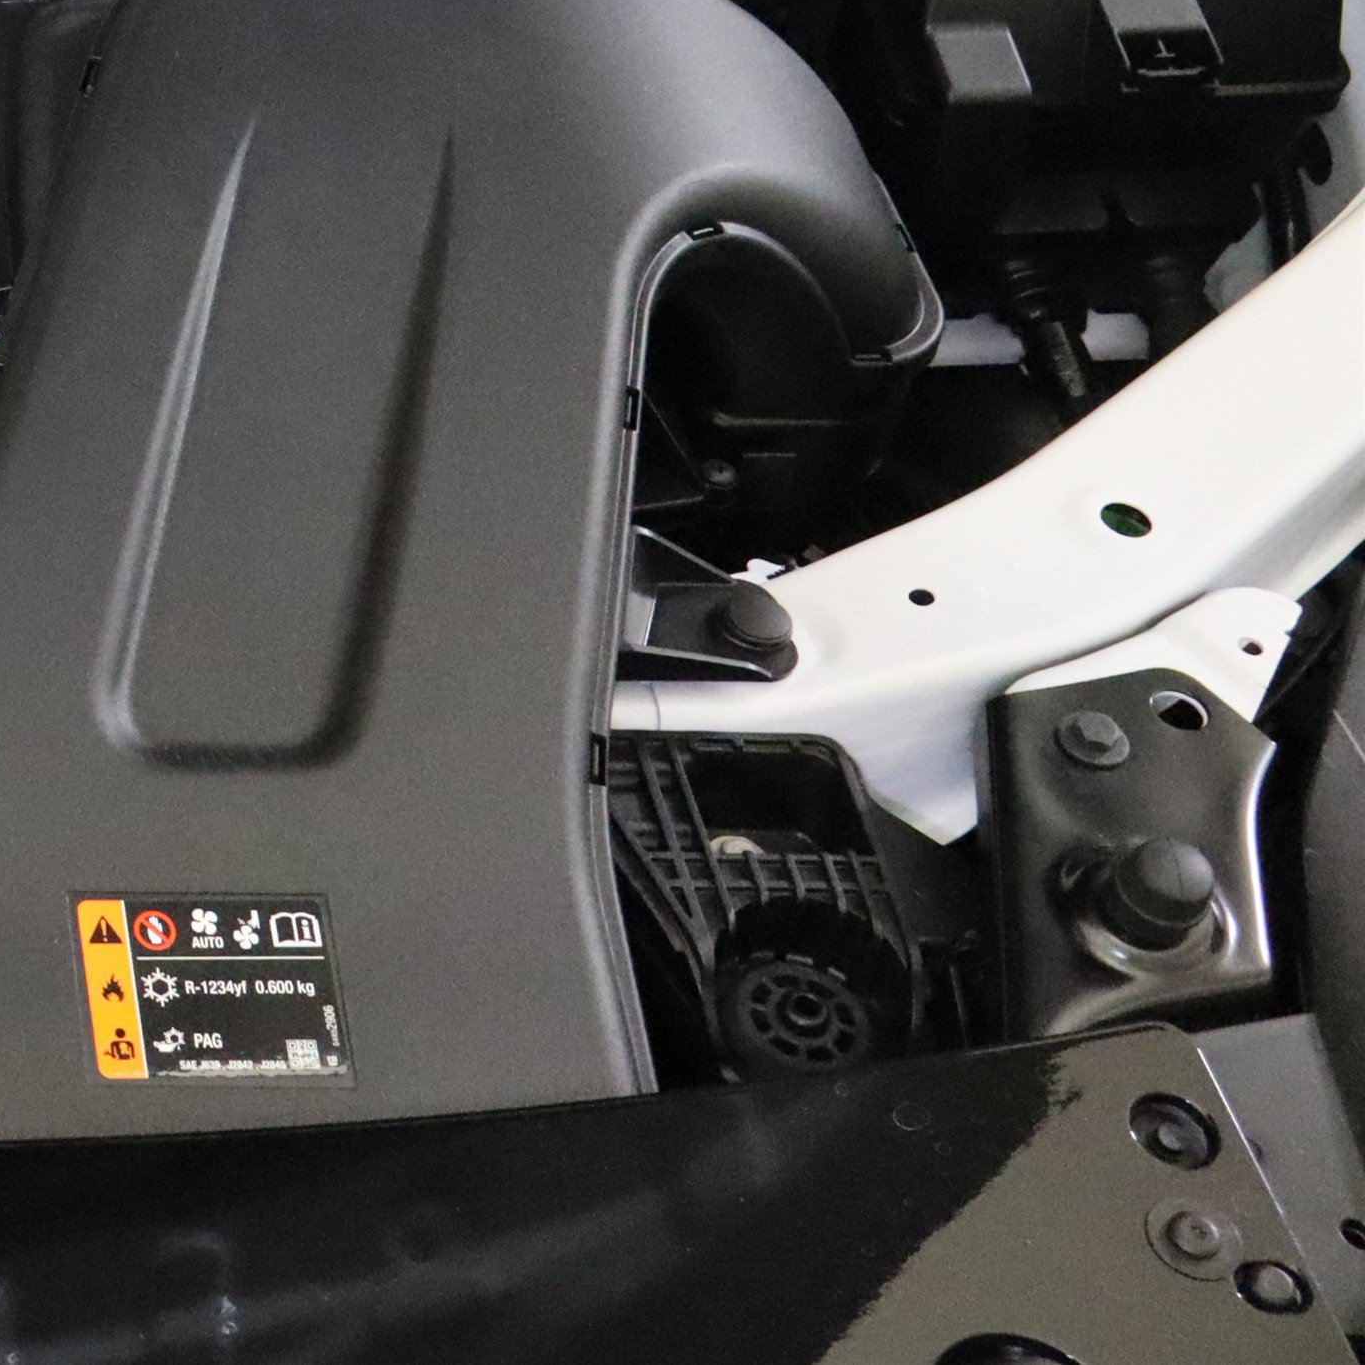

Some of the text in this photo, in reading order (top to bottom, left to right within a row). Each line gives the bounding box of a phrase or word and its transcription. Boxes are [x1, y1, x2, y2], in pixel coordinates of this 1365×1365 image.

[192, 937, 224, 949] AUTO
[184, 979, 315, 997] R-1234yf 0.600 kg
[194, 1032, 223, 1049] PAG
[180, 1059, 197, 1070] SAE
